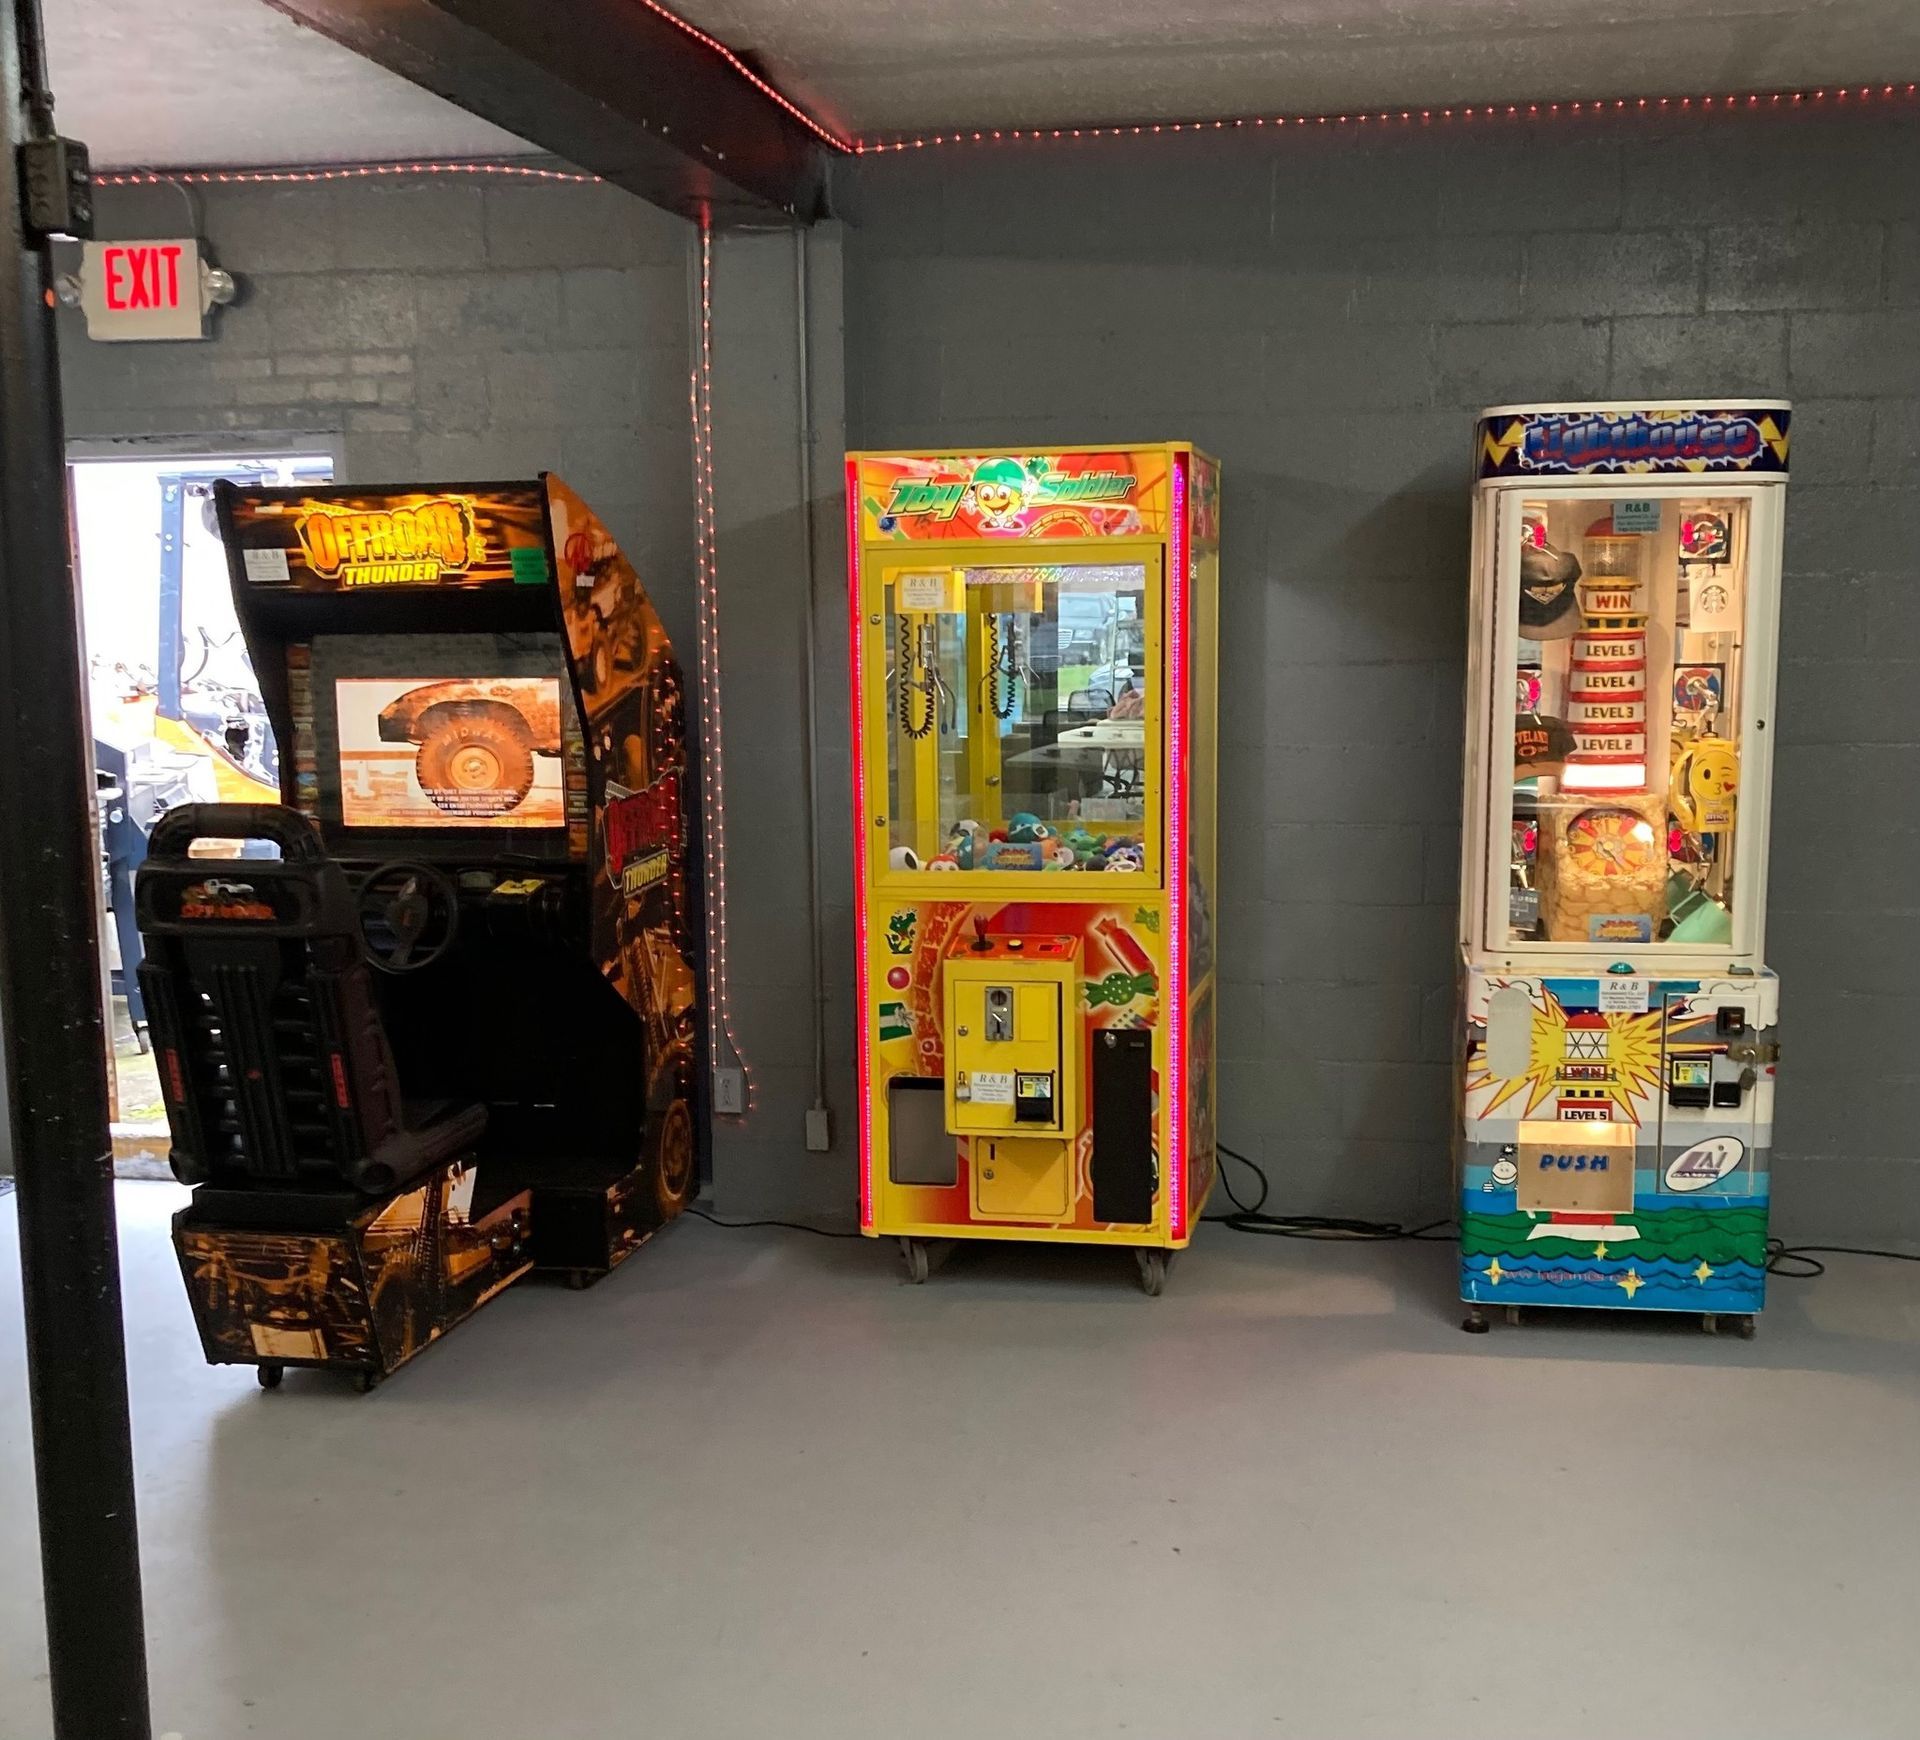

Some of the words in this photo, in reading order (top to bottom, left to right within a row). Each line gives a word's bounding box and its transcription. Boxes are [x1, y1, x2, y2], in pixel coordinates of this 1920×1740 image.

[104, 245, 182, 310] EXIT
[1527, 419, 1751, 463] Lighthouse
[888, 478, 966, 520] Toy
[1034, 473, 1135, 502] Soldier
[1625, 502, 1650, 513] R&B
[306, 501, 468, 572] OFFROAD
[344, 563, 439, 586] THUNDER
[1595, 594, 1631, 609] WIN
[1586, 644, 1625, 657] LEVEL
[1628, 644, 1635, 656] 5
[1585, 675, 1625, 688] LEVEL
[1628, 675, 1635, 687] 4
[1584, 706, 1624, 719] LEVEL
[1626, 706, 1634, 718] 3
[1582, 738, 1624, 751] LEVEL
[1625, 738, 1632, 750] 2
[1610, 981, 1618, 990] R
[1631, 981, 1639, 990] B
[980, 1074, 988, 1083] R
[1571, 1067, 1601, 1078] WIN
[1564, 1110, 1595, 1121] LEVEL
[1599, 1111, 1607, 1121] 5
[1540, 1153, 1610, 1171] PUSH
